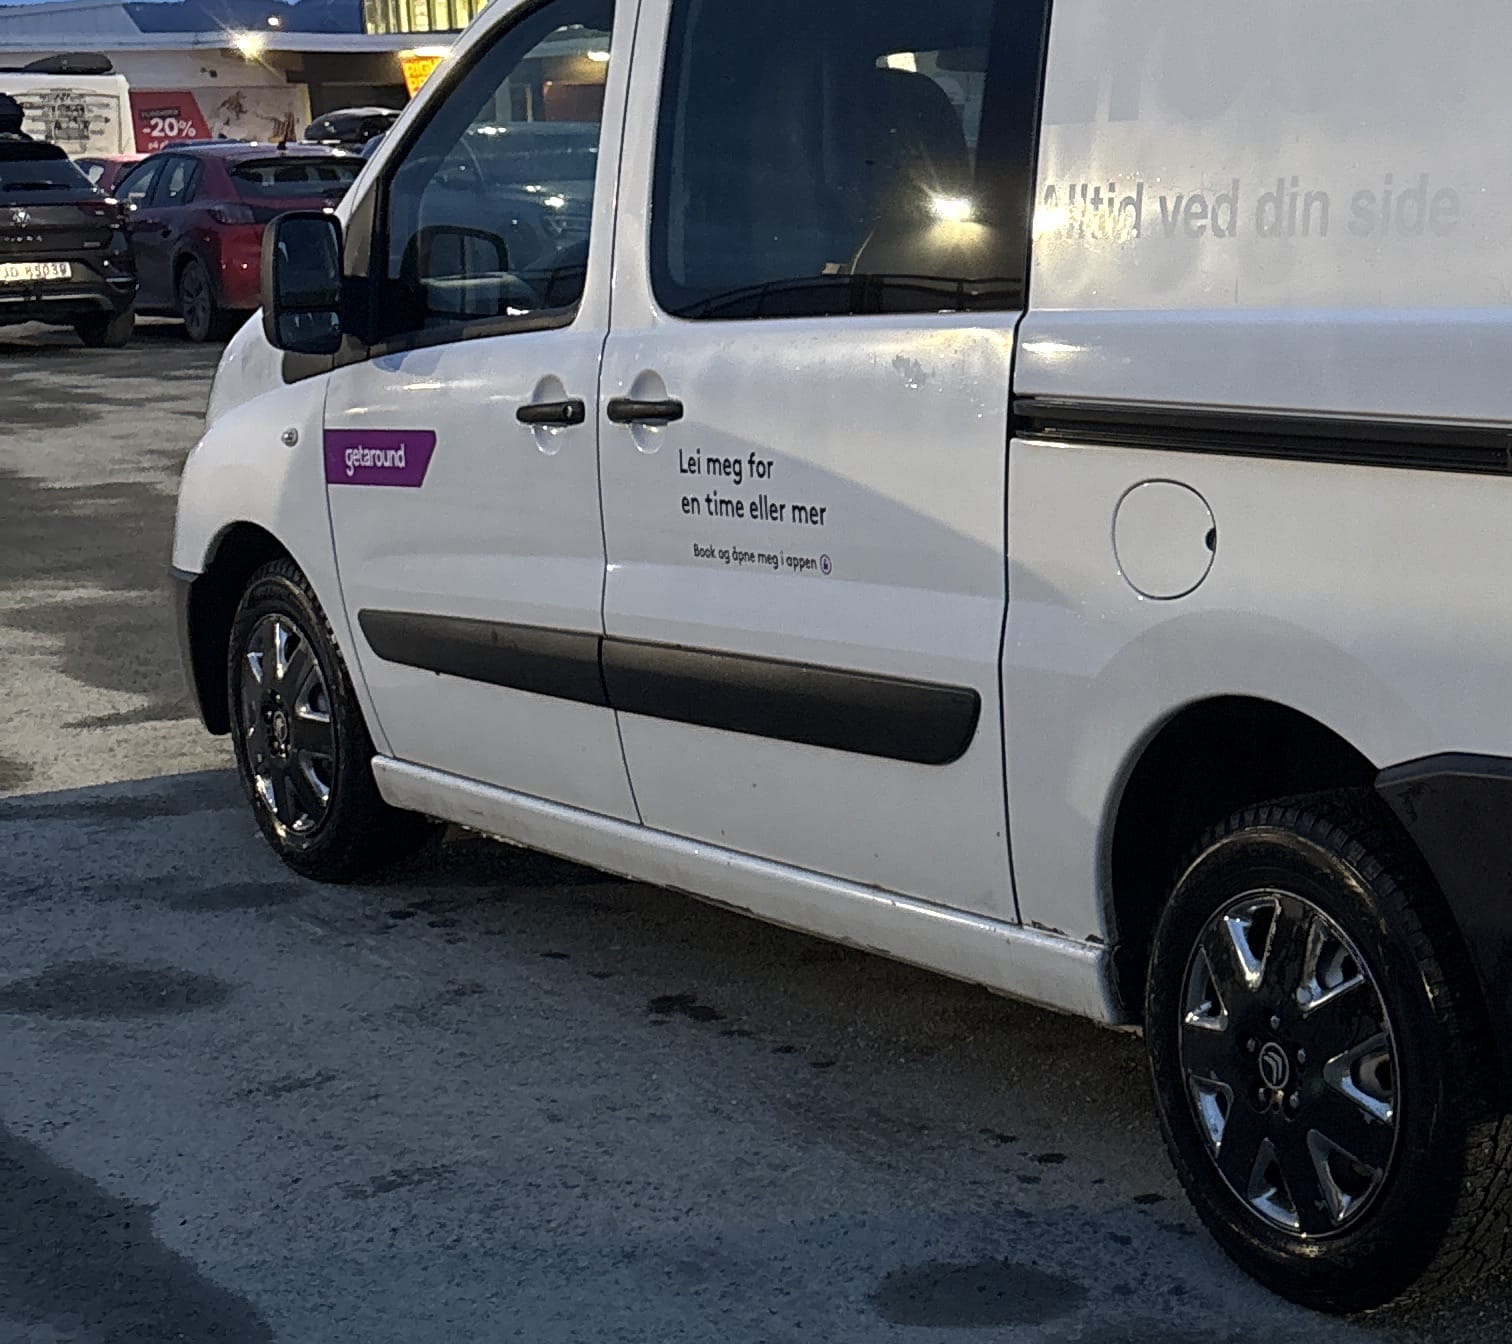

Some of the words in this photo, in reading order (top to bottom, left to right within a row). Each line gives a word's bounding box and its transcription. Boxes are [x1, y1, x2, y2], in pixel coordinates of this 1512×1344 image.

[142, 117, 197, 137] -20%
[1159, 178, 1240, 238] ved
[1256, 175, 1330, 238] din
[1348, 172, 1461, 237] side
[345, 443, 405, 476] getaround
[679, 448, 701, 474] Lei
[706, 457, 742, 485] meg
[748, 451, 773, 479] for
[681, 495, 700, 515] en
[705, 490, 745, 518] time
[750, 494, 786, 522] eller
[792, 504, 826, 526] mer
[693, 543, 716, 559] Book
[718, 549, 730, 564] og
[732, 546, 755, 565] åpne
[757, 555, 778, 570] meg
[780, 551, 785, 565] i
[786, 558, 817, 571] appen
